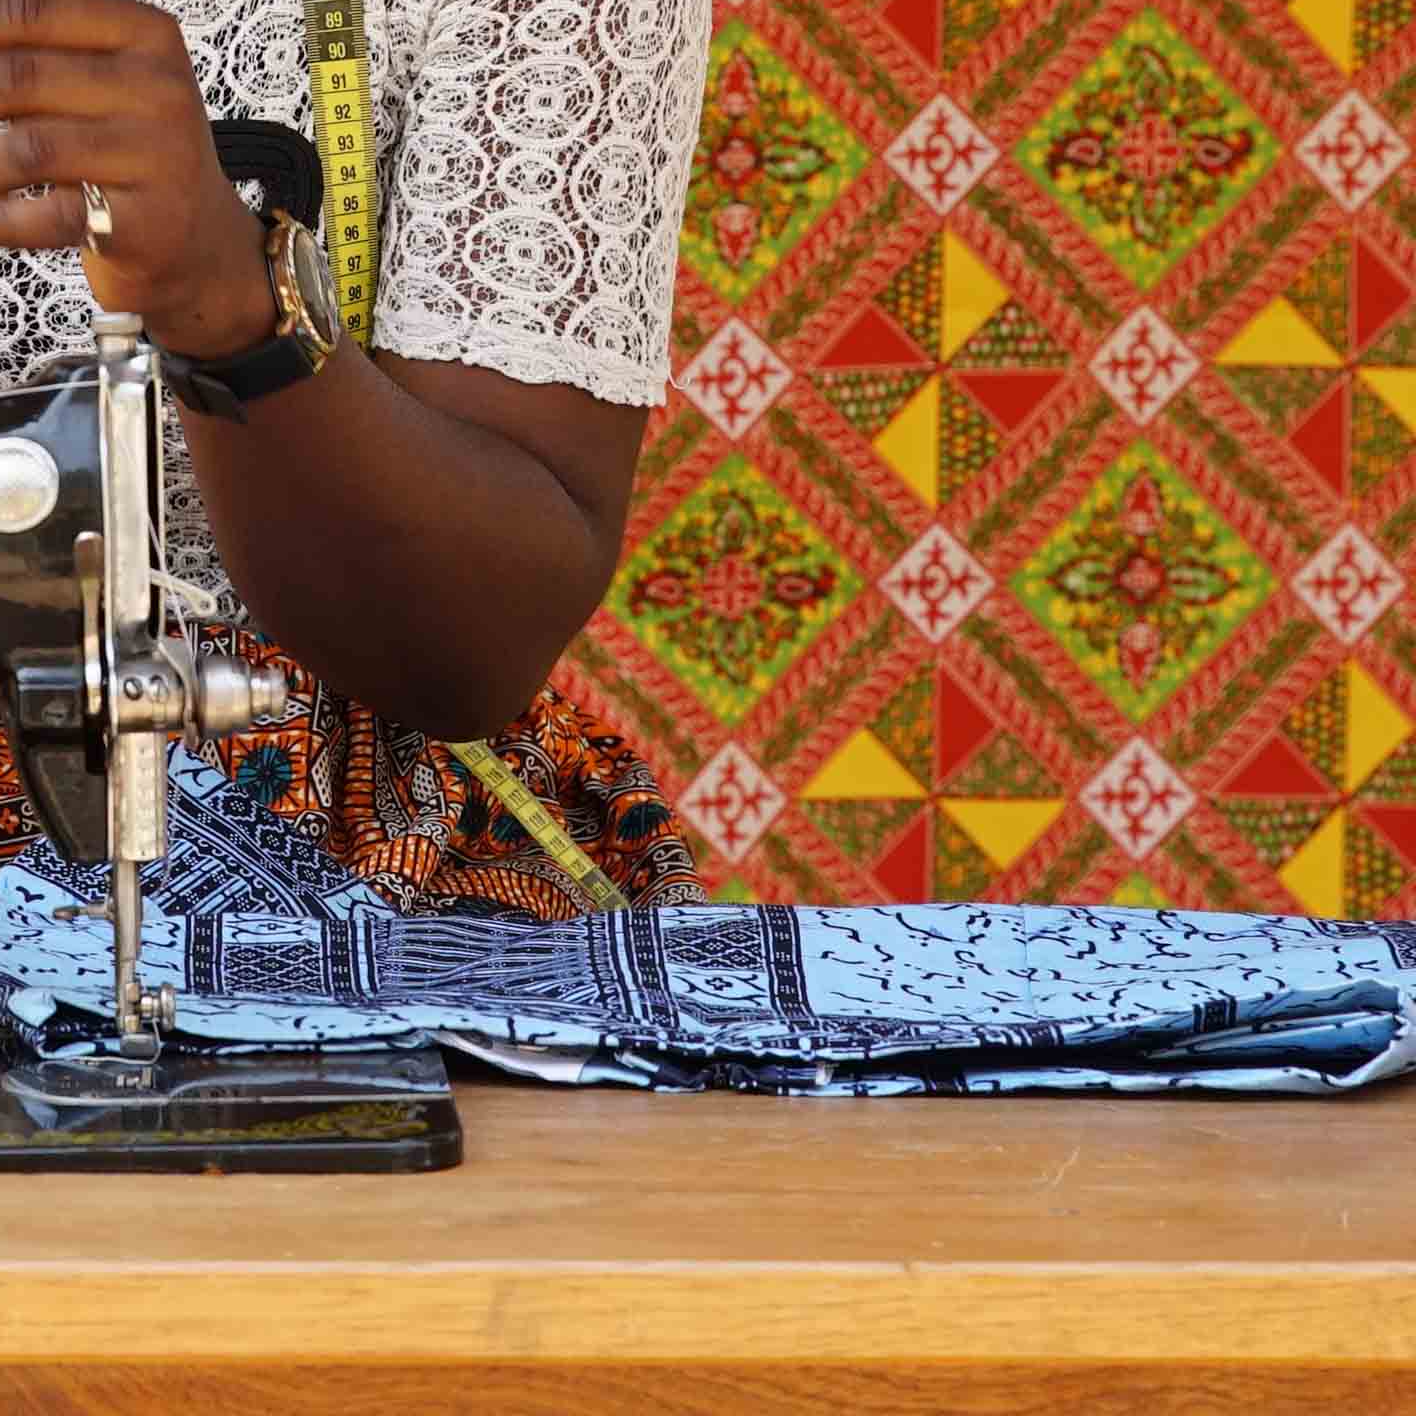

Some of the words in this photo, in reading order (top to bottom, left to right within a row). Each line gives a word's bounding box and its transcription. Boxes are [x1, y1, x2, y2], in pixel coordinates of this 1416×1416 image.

[325, 12, 344, 28] 89
[328, 42, 346, 59] 90
[331, 72, 348, 90] 91
[334, 103, 352, 120] 92
[337, 134, 355, 151] 93
[340, 165, 357, 182] 94
[343, 195, 360, 212] 95
[344, 225, 360, 242] 96
[347, 255, 362, 272] 97
[347, 284, 362, 301] 98
[347, 314, 362, 330] 99
